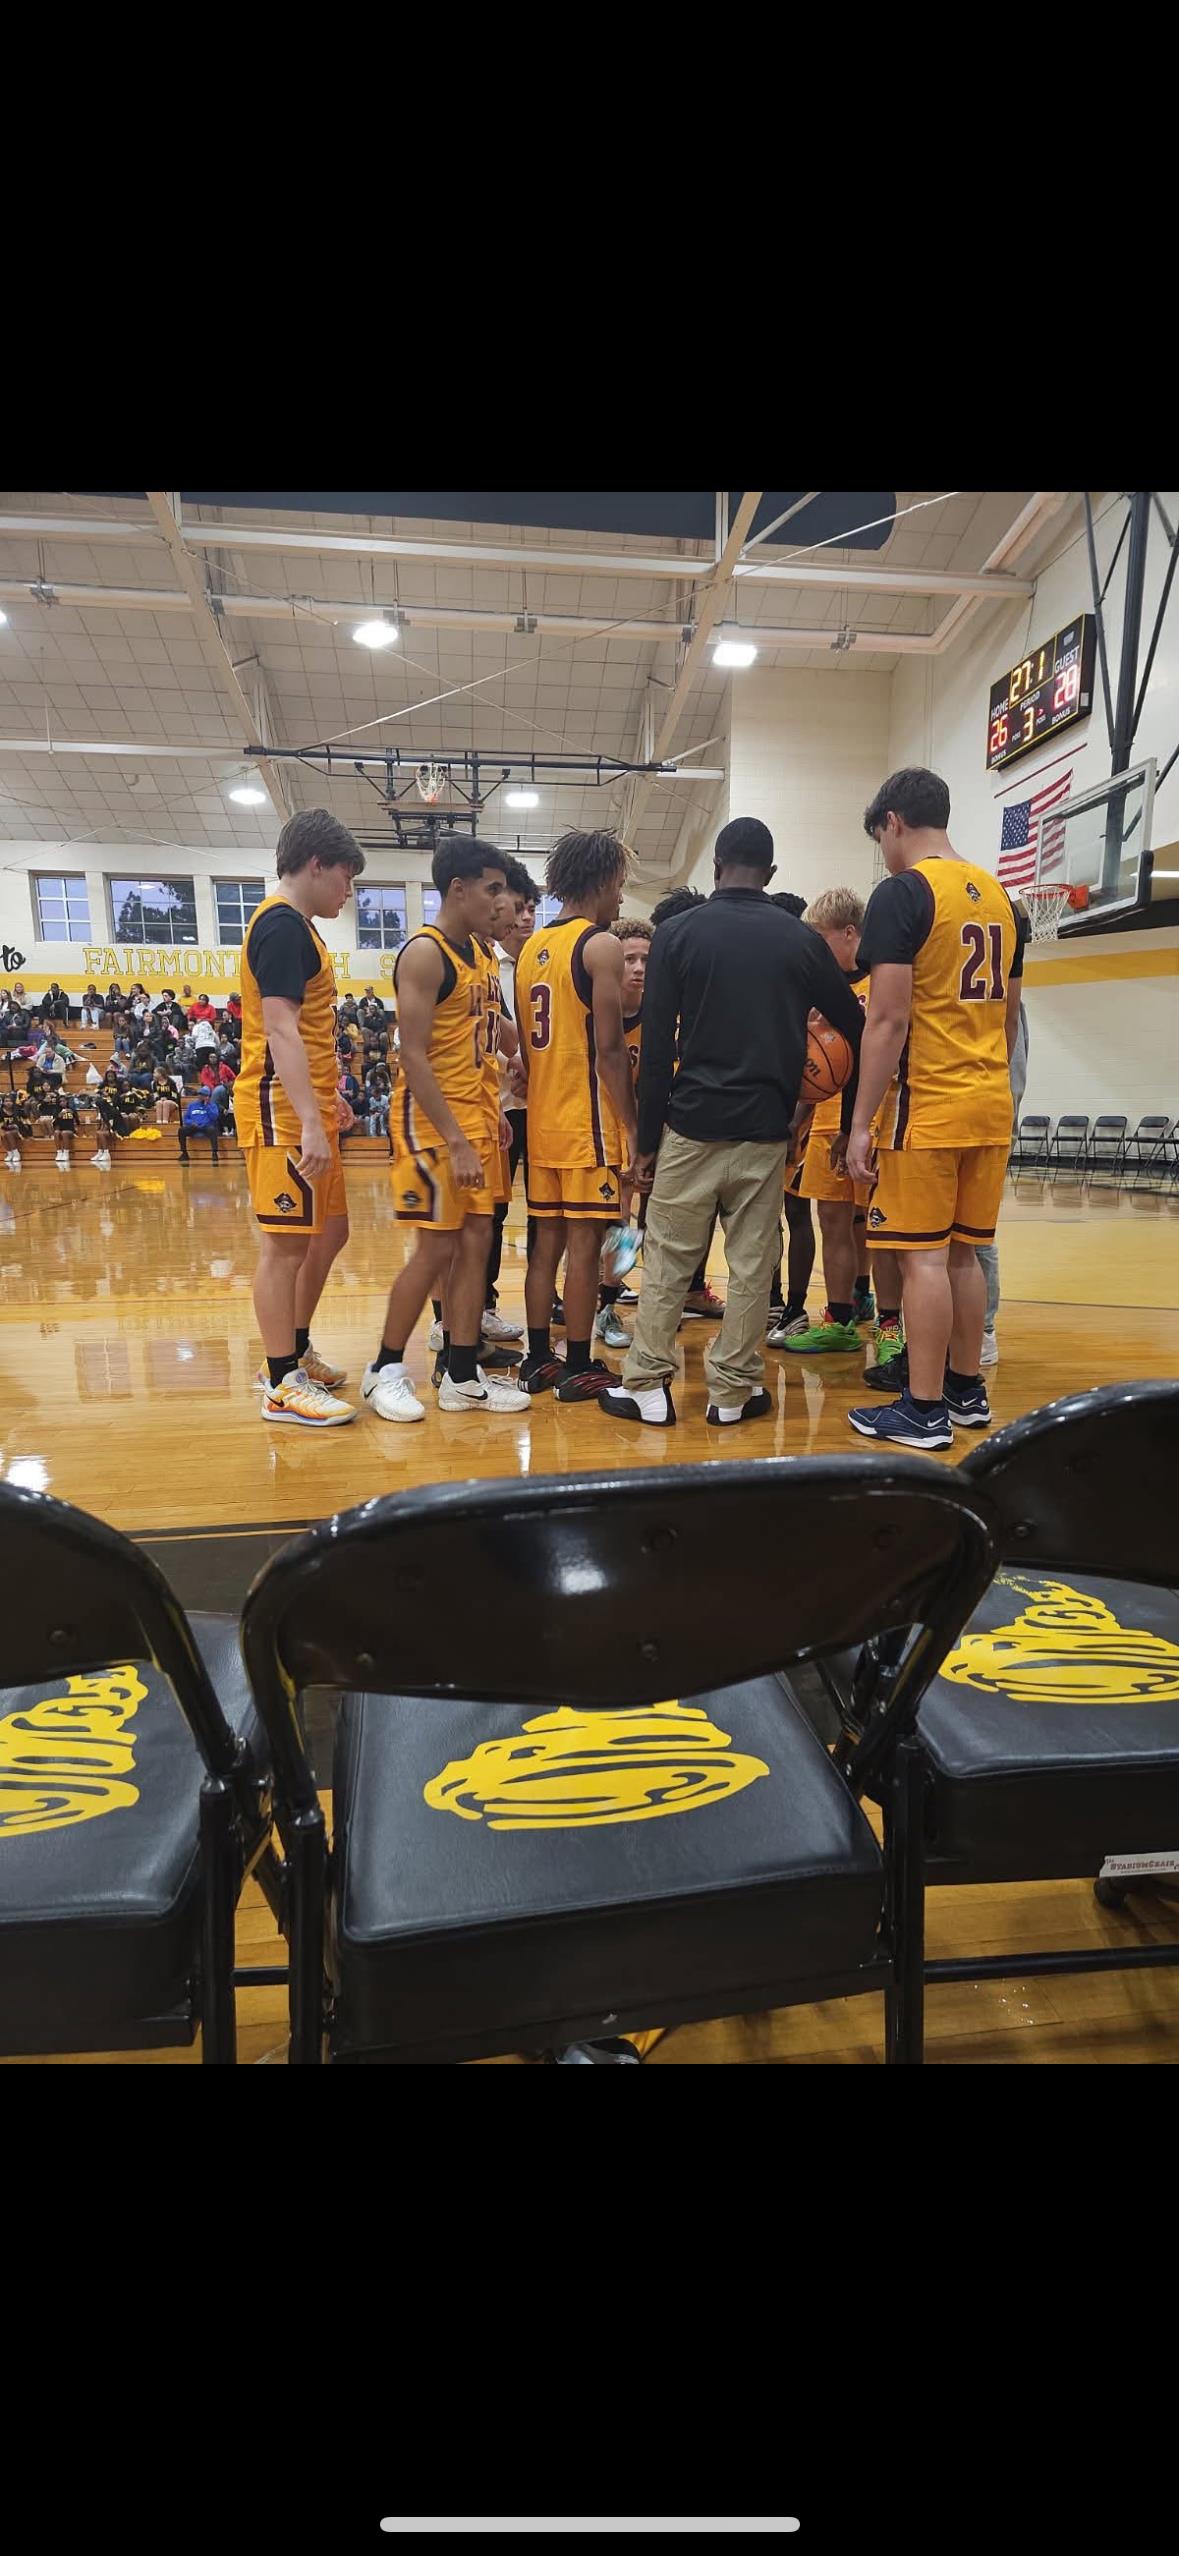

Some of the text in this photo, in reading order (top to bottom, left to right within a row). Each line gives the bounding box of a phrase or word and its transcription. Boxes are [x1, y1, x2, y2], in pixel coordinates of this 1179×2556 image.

[1055, 645, 1080, 673] GUEST
[1020, 691, 1041, 711] PERIOD
[1054, 664, 1078, 709] 28
[991, 698, 1009, 720] HOME
[1052, 708, 1071, 725] BONUS
[990, 713, 1008, 752] 26
[1023, 707, 1035, 742] 3
[991, 750, 1007, 763] BONUS
[0, 945, 26, 972] to
[82, 947, 242, 977] FAIRMONT
[959, 922, 1005, 1002] 21
[530, 982, 553, 1051] 3
